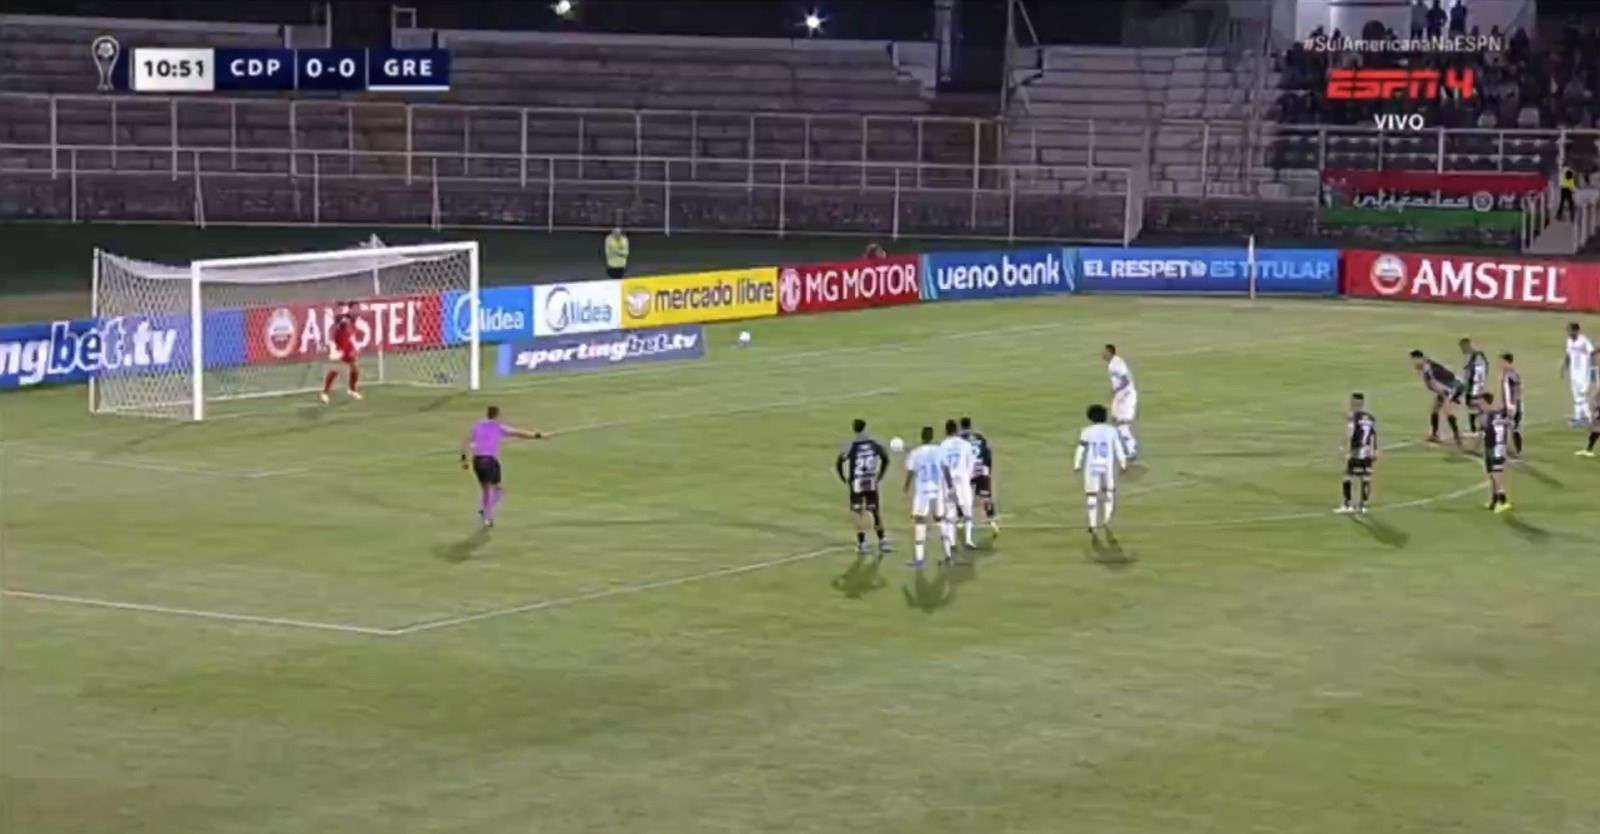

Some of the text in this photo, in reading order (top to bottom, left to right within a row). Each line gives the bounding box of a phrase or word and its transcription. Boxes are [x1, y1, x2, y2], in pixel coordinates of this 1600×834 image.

[805, 263, 919, 304] MG MOTOR
[937, 252, 1061, 291] ueno bank
[1082, 259, 1109, 277] EL
[1210, 259, 1236, 278] ES
[1239, 259, 1332, 280] TTULAR
[1410, 257, 1567, 304] AMSTEL
[653, 277, 775, 315] mercado libre
[514, 332, 698, 370] sportingbet.tv
